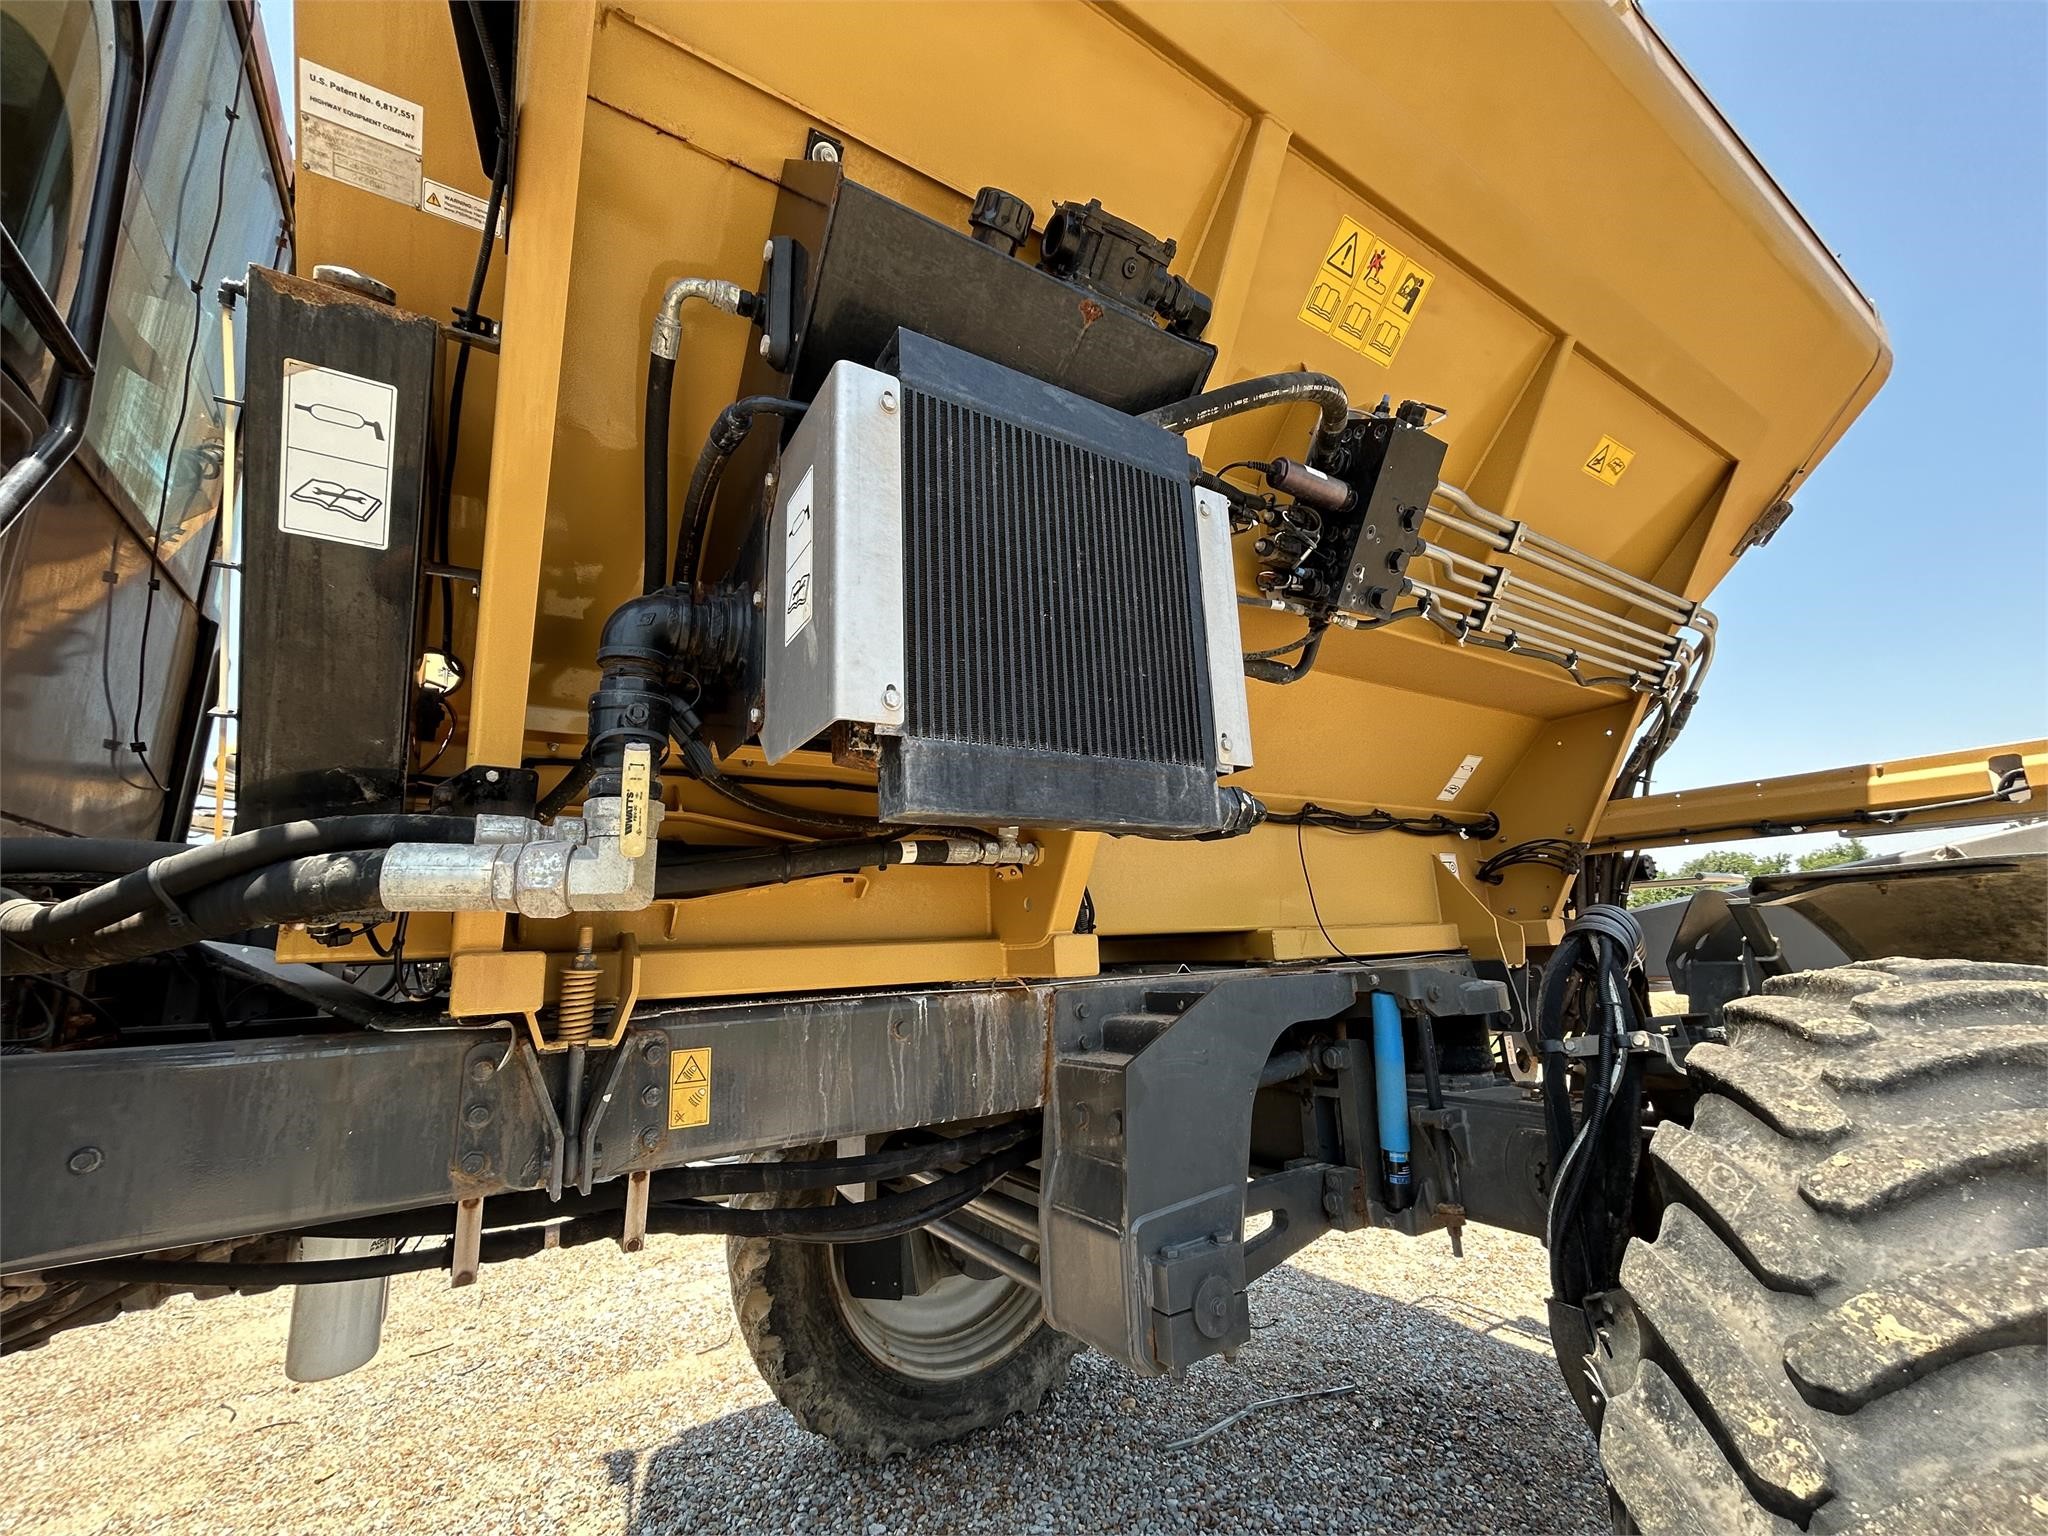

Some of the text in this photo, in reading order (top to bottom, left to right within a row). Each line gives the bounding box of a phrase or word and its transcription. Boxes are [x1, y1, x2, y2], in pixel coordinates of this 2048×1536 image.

[309, 73, 416, 121] U.S. Patent No. 6,817,551
[309, 95, 416, 141] HIGHWAY EQUIPMENT COMPANY
[624, 791, 634, 835] WATTS
